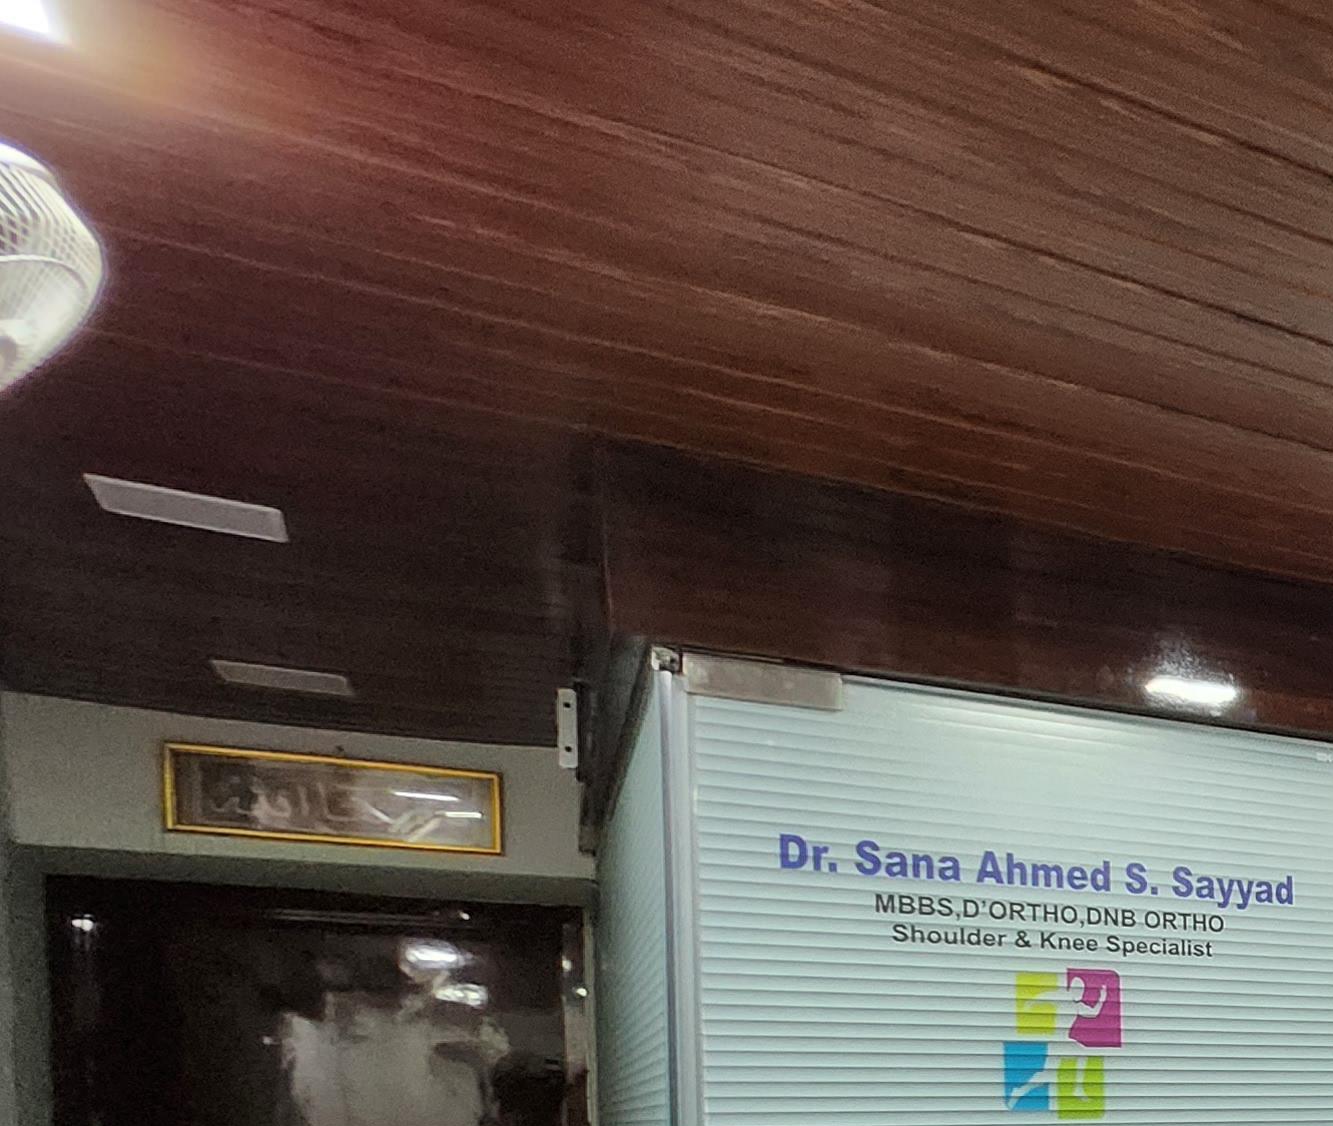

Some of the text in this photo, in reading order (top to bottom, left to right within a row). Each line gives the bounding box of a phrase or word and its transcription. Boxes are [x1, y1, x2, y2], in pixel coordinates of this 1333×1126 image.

[780, 834, 1294, 910] Dr. Sana Ahmed S. Sayyad
[1144, 911, 1225, 933] ORTHO
[892, 924, 1213, 957] Shoulder & Knee Specialist
